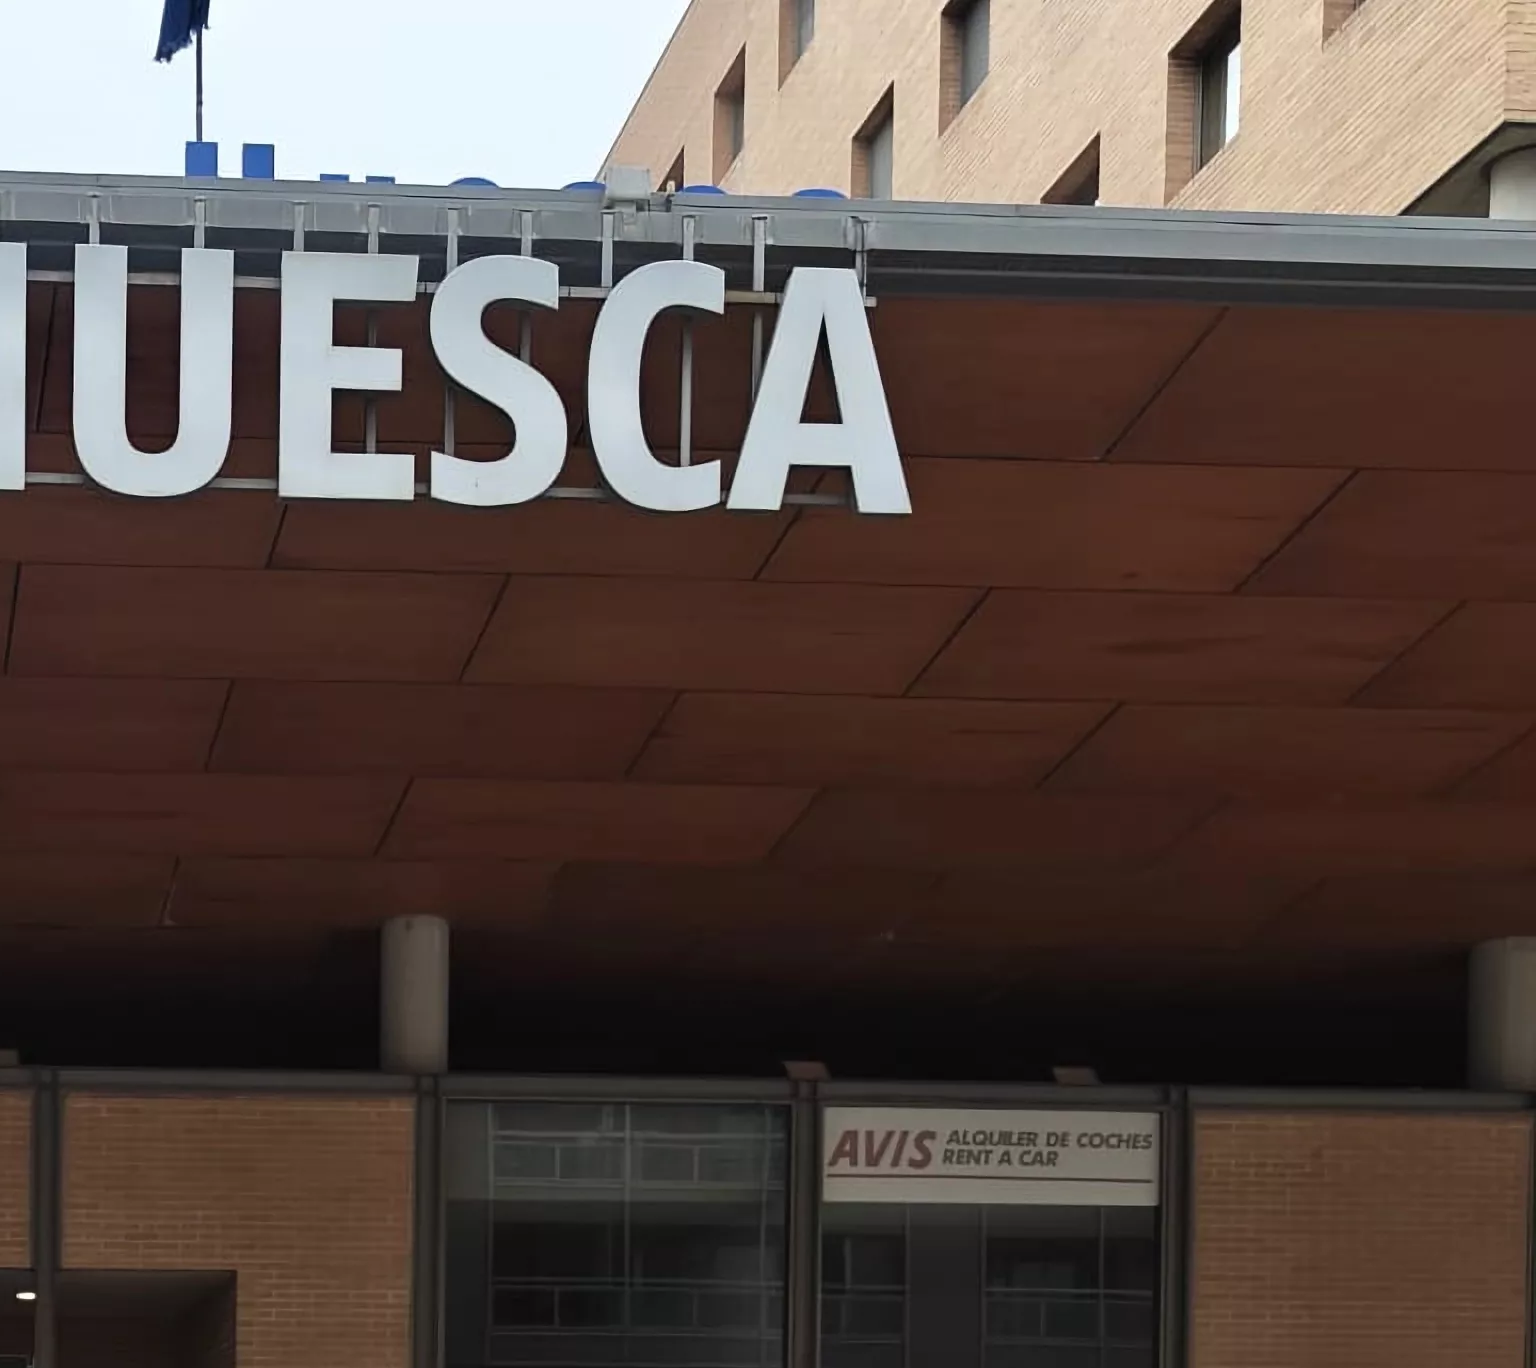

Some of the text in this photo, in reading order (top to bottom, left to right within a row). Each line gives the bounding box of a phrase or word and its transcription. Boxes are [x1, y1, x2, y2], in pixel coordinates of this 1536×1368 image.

[827, 1129, 937, 1170] AVIS
[945, 1129, 1154, 1150] ALQUILER DE COCHES
[942, 1148, 1059, 1167] RENT A CAR
